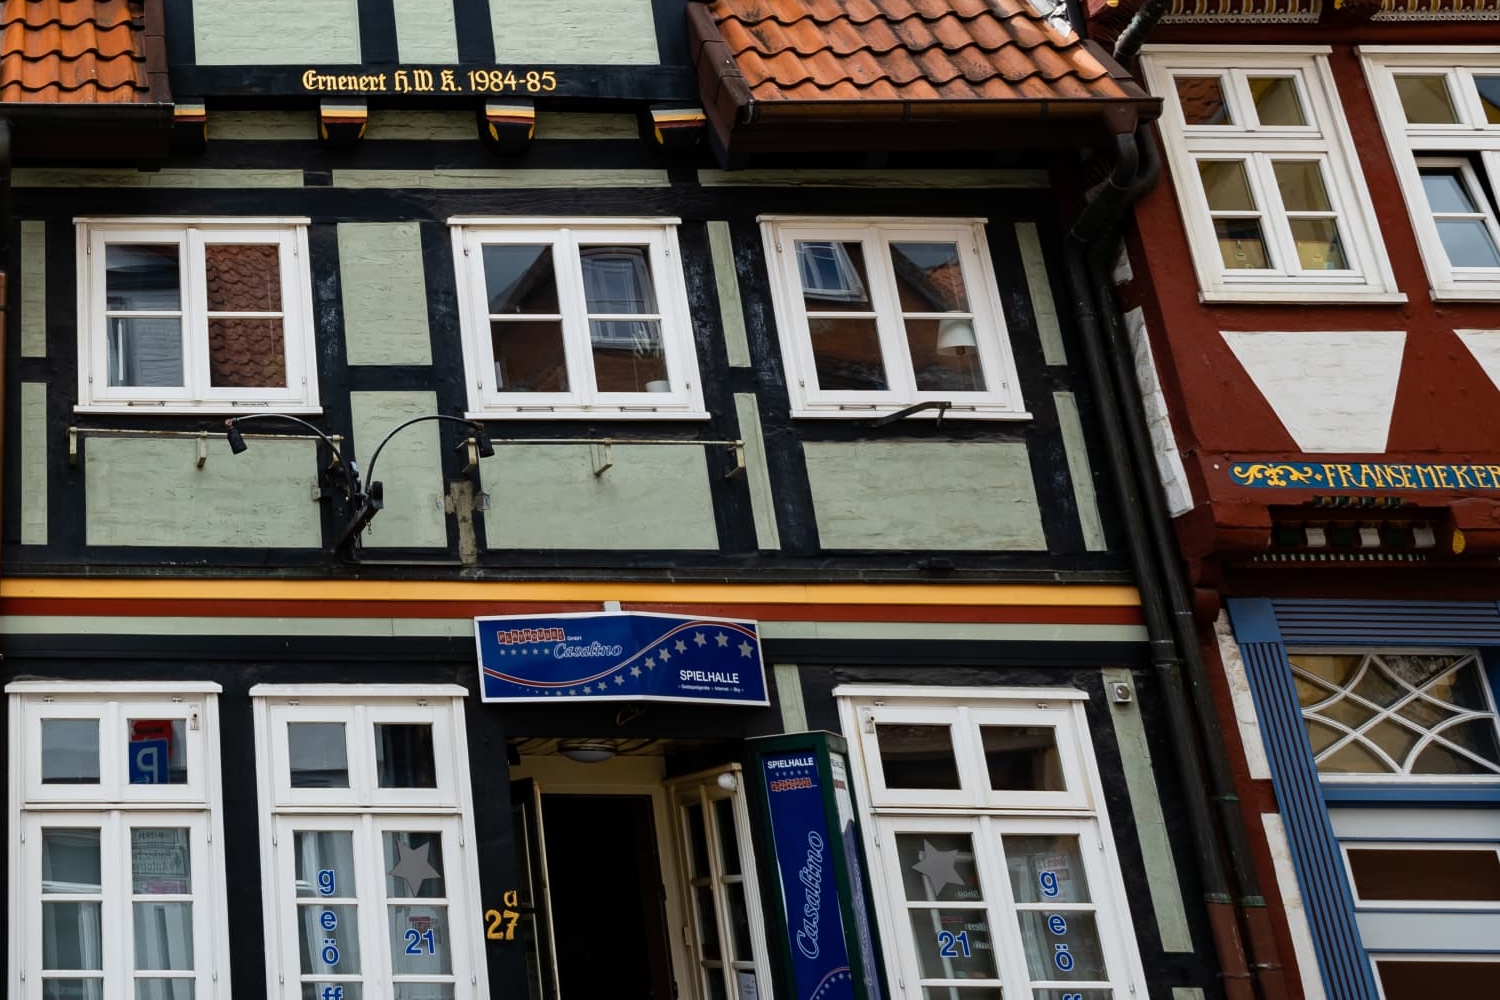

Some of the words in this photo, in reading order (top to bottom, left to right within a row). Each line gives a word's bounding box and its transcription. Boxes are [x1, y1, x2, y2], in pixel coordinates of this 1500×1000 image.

[467, 69, 557, 92] 1984-85
[553, 641, 623, 659] Casalino
[679, 669, 740, 684] SPIELHALLE
[767, 757, 815, 769] SPIELHALLE
[796, 830, 825, 960] Casalino
[485, 909, 520, 940] 27
[404, 928, 436, 955] 21
[938, 931, 972, 958] 21
